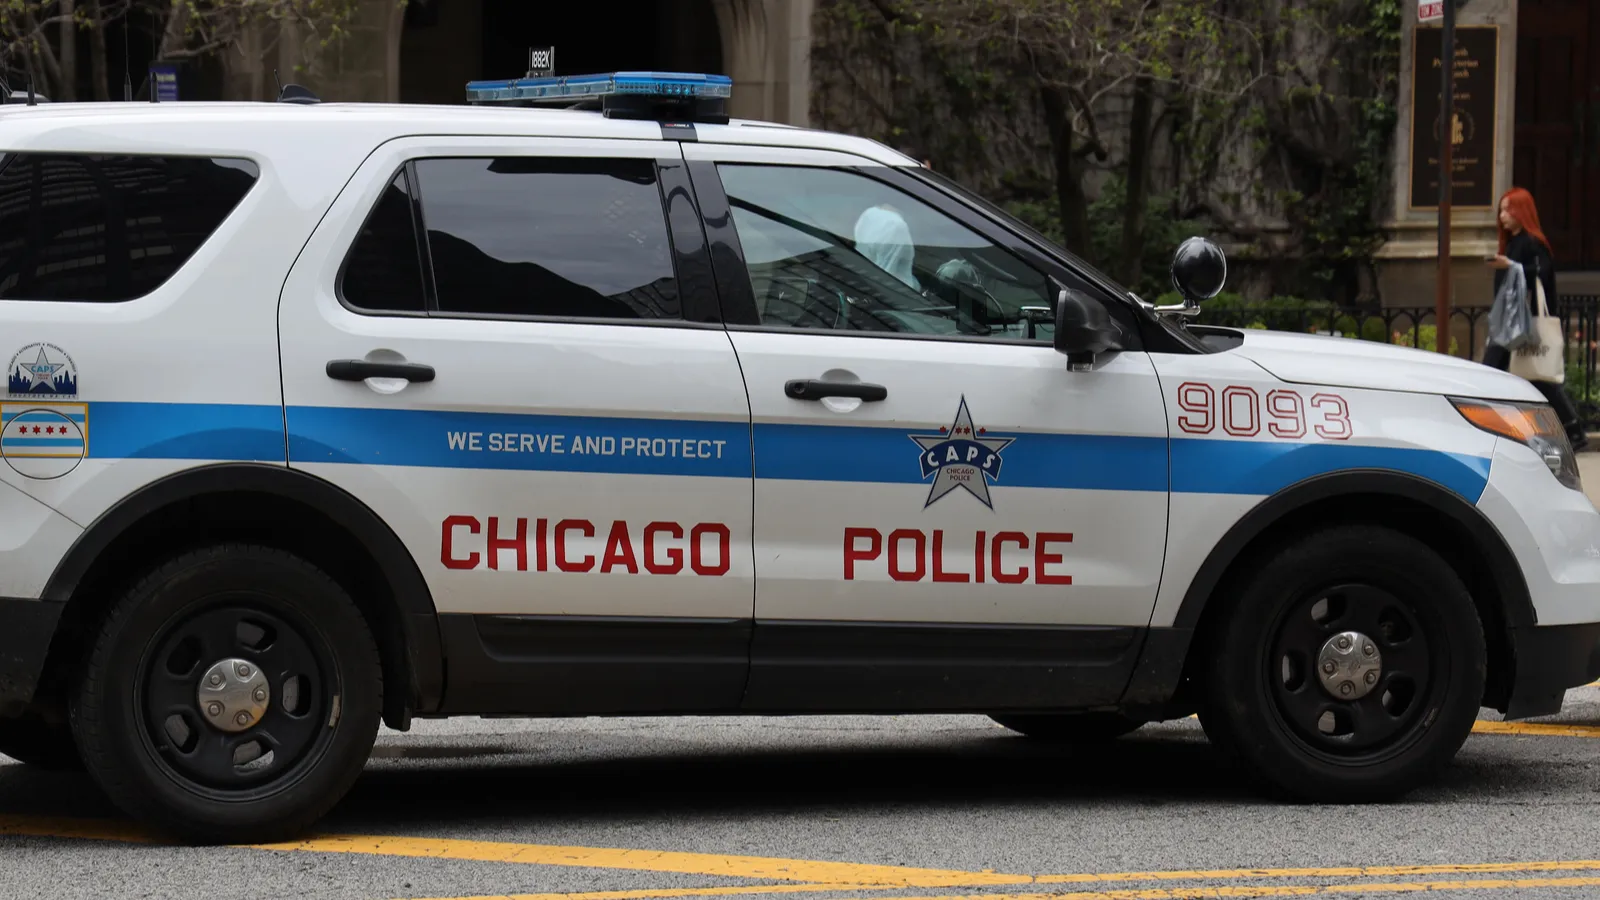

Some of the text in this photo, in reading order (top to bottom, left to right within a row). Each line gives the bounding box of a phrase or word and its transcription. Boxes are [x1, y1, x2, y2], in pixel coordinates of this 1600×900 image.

[30, 365, 55, 373] CAPS
[1178, 382, 1353, 440] 9093
[447, 432, 726, 459] WE SERVE AND PROTECT
[926, 445, 996, 469] CAPS
[440, 515, 1074, 586] CHICAGO POLICE
